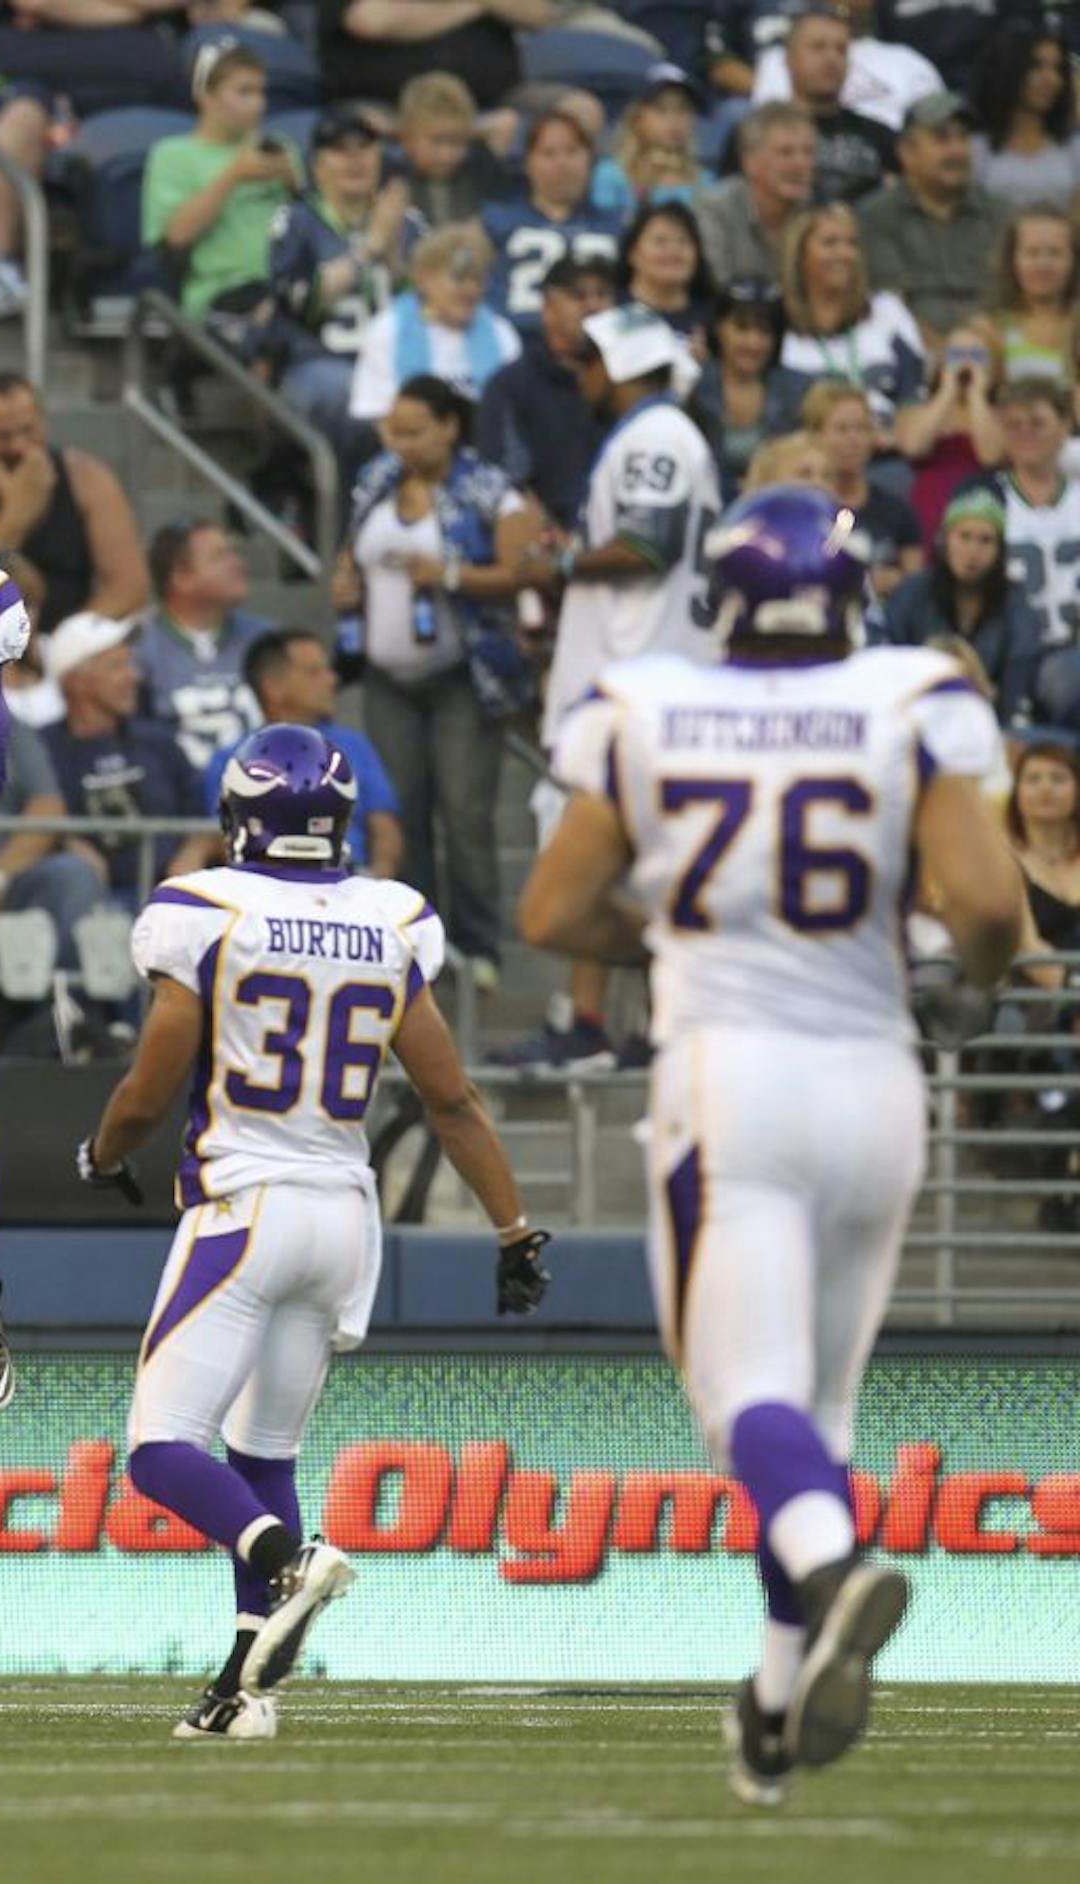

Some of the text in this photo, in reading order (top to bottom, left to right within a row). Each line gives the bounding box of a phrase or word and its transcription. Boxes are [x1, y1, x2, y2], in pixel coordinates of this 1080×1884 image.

[624, 453, 677, 491] 59
[660, 776, 873, 932] 76
[266, 917, 384, 963] BURTON
[224, 971, 396, 1121] 36
